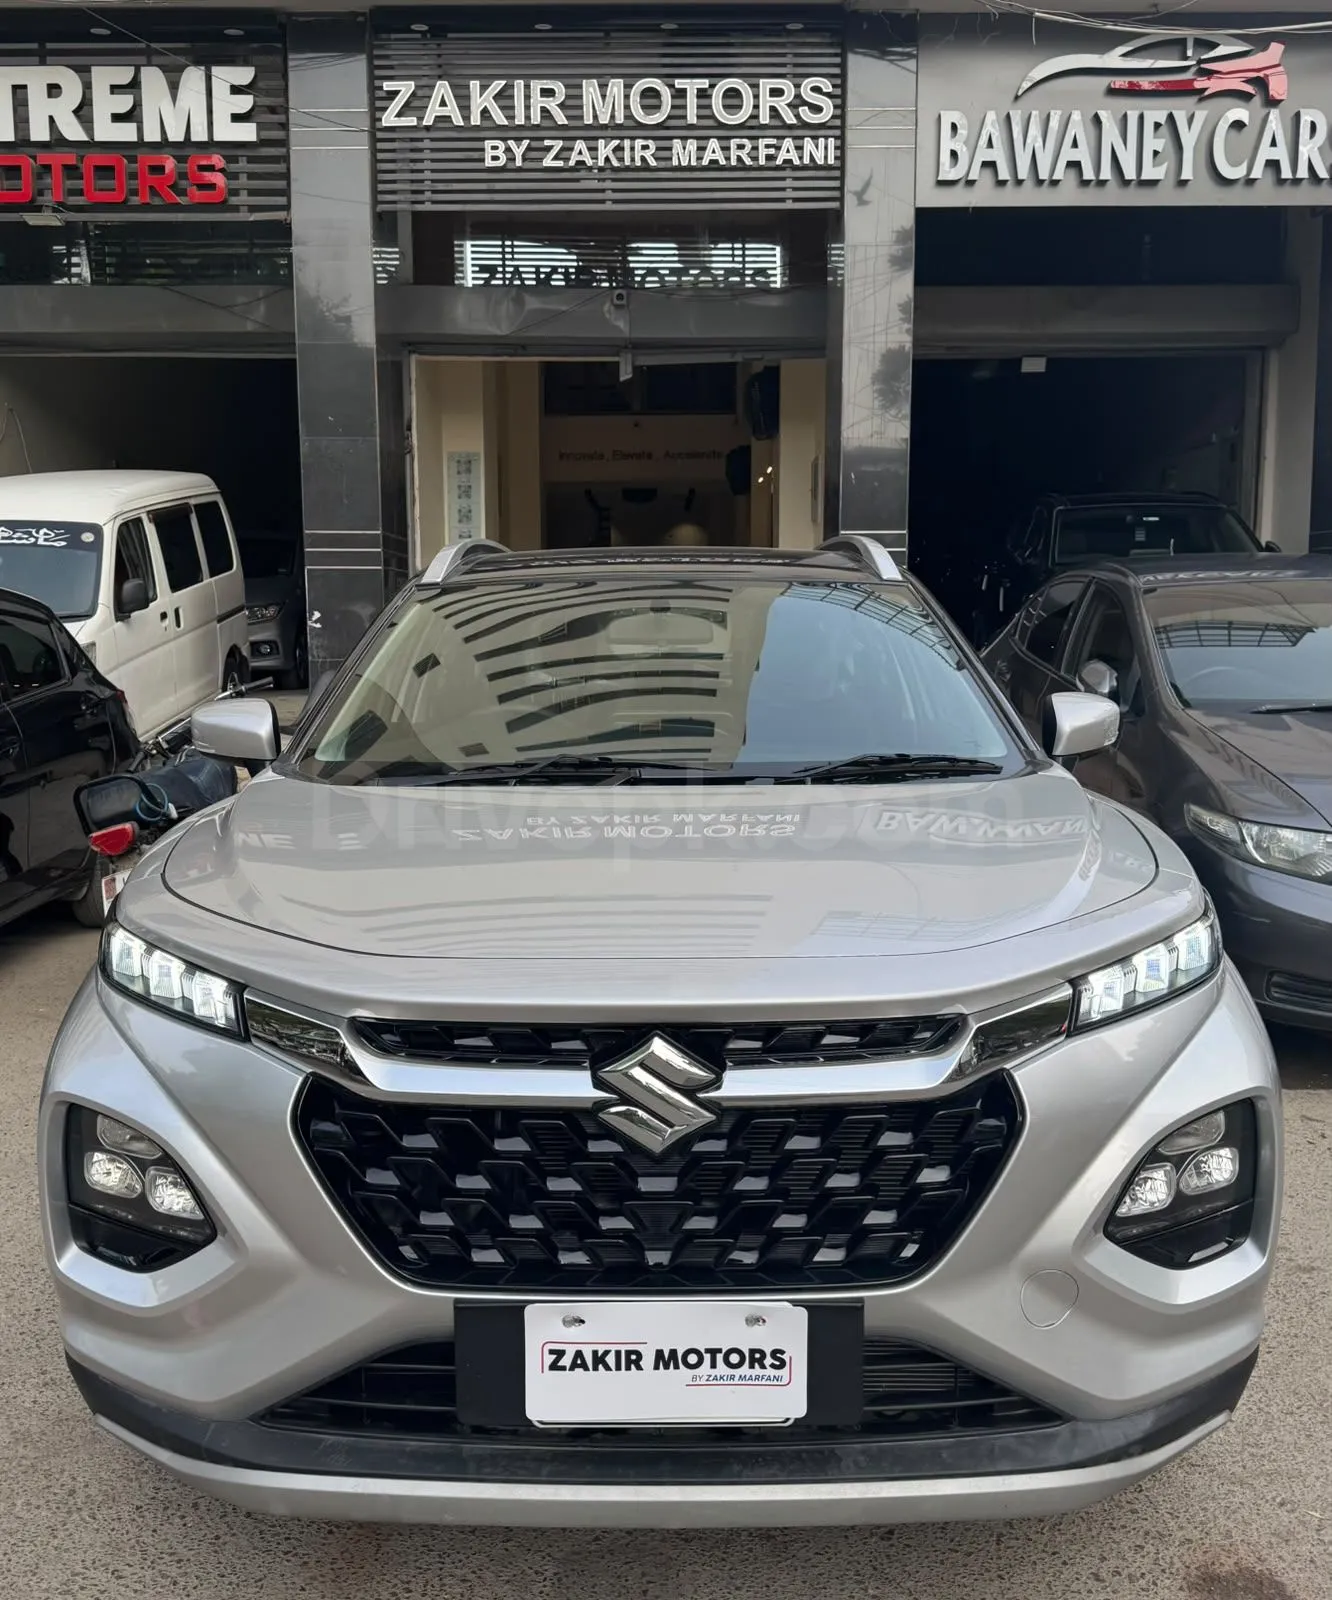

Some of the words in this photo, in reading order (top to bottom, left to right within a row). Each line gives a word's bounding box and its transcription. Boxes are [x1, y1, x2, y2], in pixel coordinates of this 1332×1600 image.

[381, 80, 568, 127] ZAKIR
[583, 77, 834, 125] MOTORS
[484, 139, 530, 167] BY
[542, 139, 656, 167] ZAKIR
[672, 137, 836, 166] MARFANI
[936, 109, 1208, 182] BAWANEY
[548, 1349, 643, 1372] ZAKIR
[653, 1347, 787, 1371] MOTORS
[691, 1375, 704, 1383] BY
[705, 1374, 736, 1382] ZAKIR
[738, 1374, 783, 1383] MARFANI
